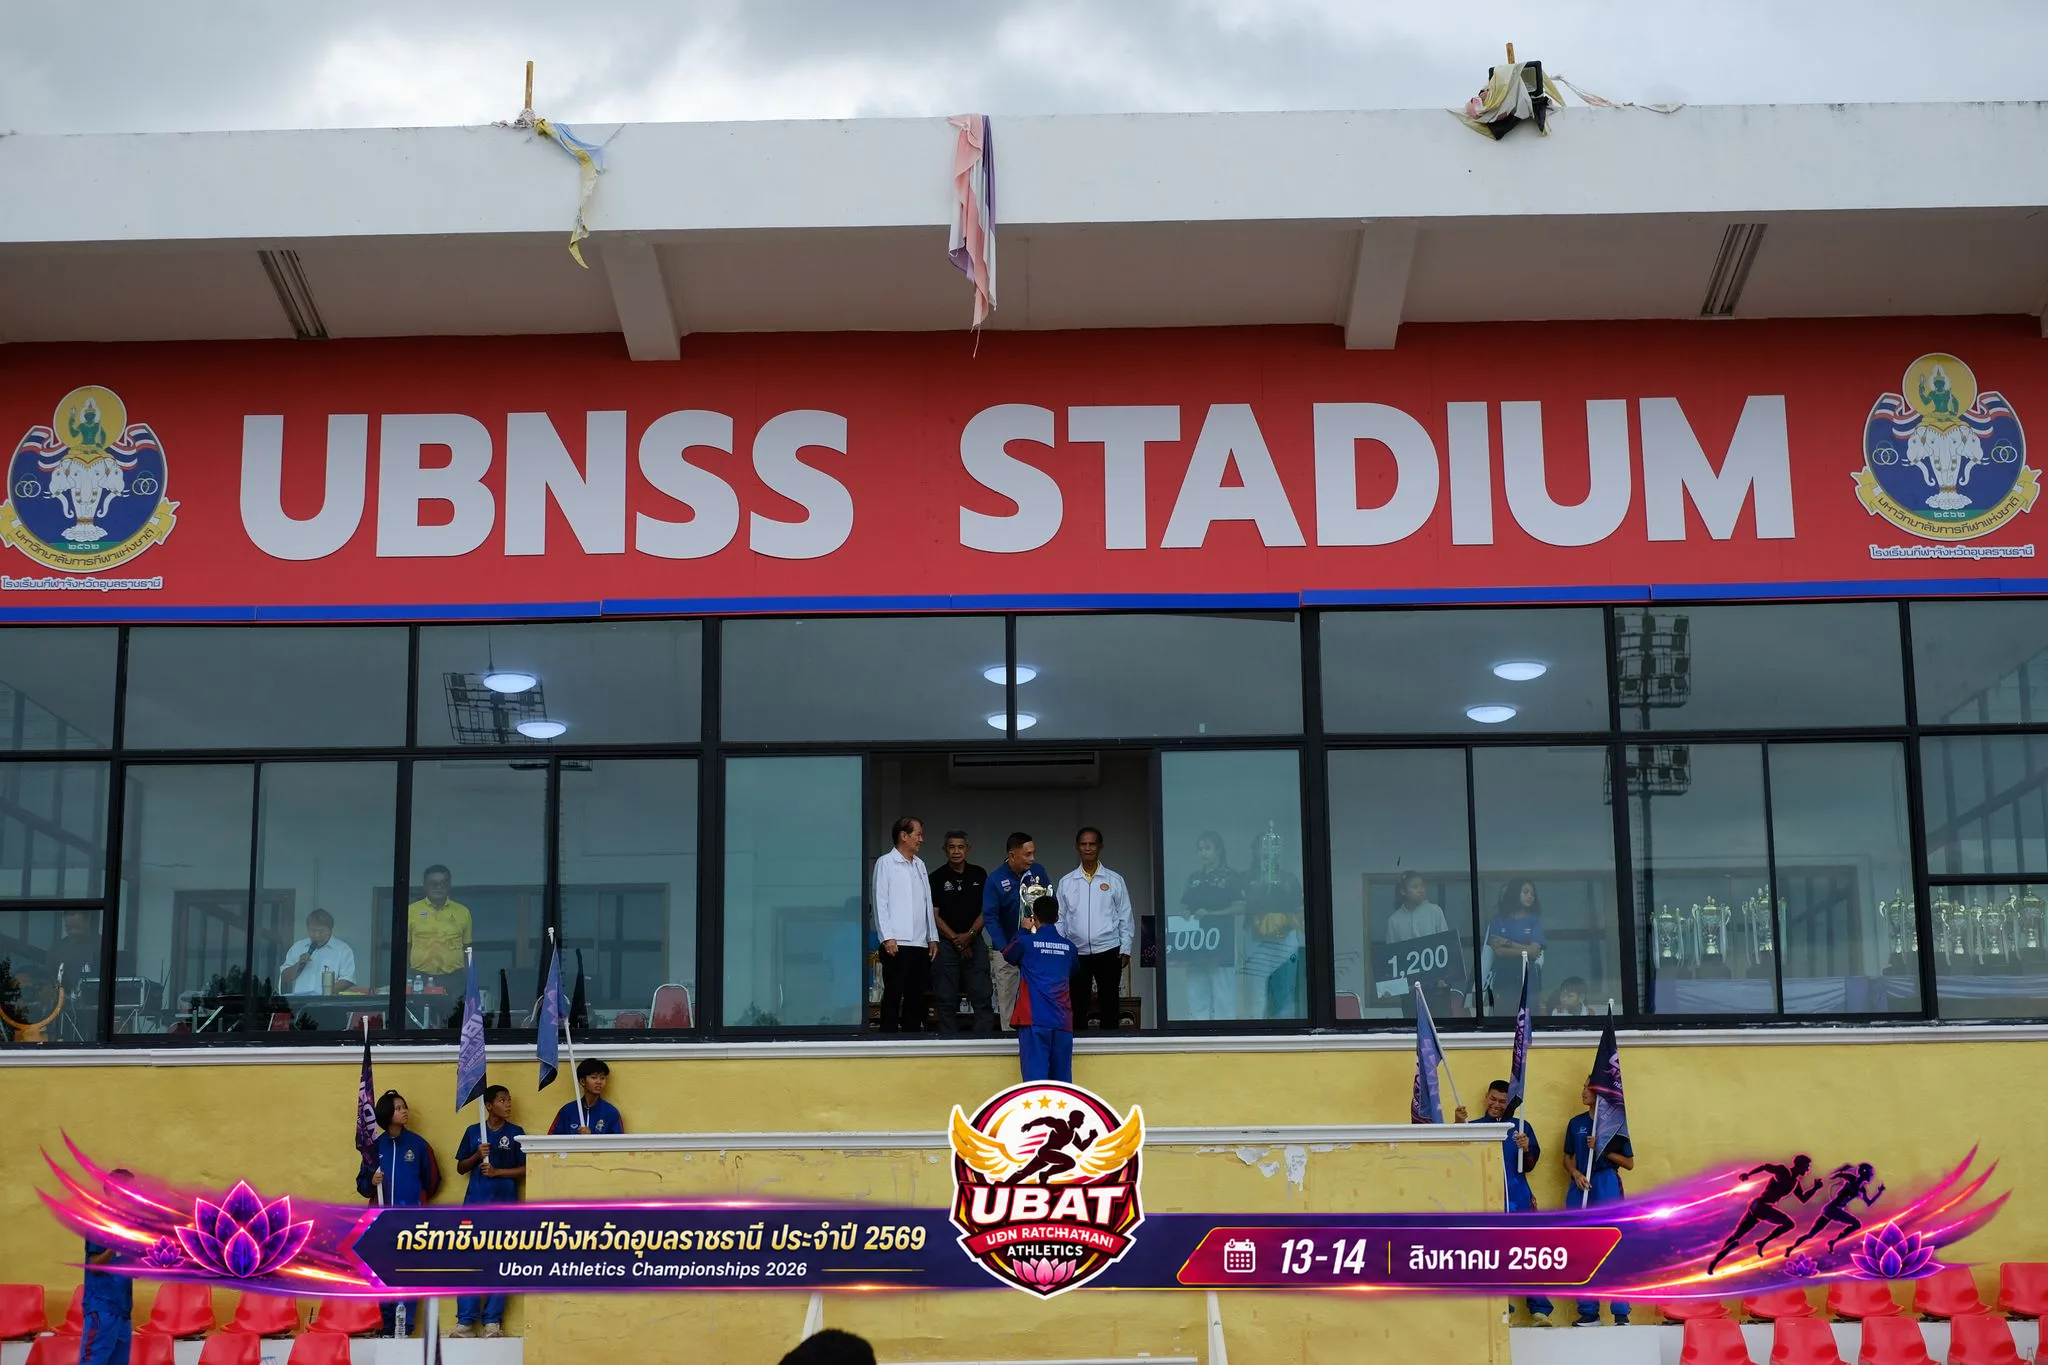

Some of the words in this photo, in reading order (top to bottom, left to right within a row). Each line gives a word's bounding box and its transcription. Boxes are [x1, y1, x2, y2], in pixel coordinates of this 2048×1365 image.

[240, 409, 854, 561] UBNSS
[959, 395, 1796, 553] STADIUM
[1878, 495, 2020, 535] มหาวิทยาลัยการกีฬาแห่งชาติ
[15, 528, 155, 567] มหาวิทยาลัยการกีฬาแห่งชาติ
[1871, 546, 2034, 559] โรงเรียนกีฬาจังหวัดอุบลราชธานี
[2, 576, 162, 590] โรงเรียนกีฬาจังหวัดอุบลราชธานี
[1165, 927, 1220, 954] ,000
[1388, 945, 1448, 980] 1,200
